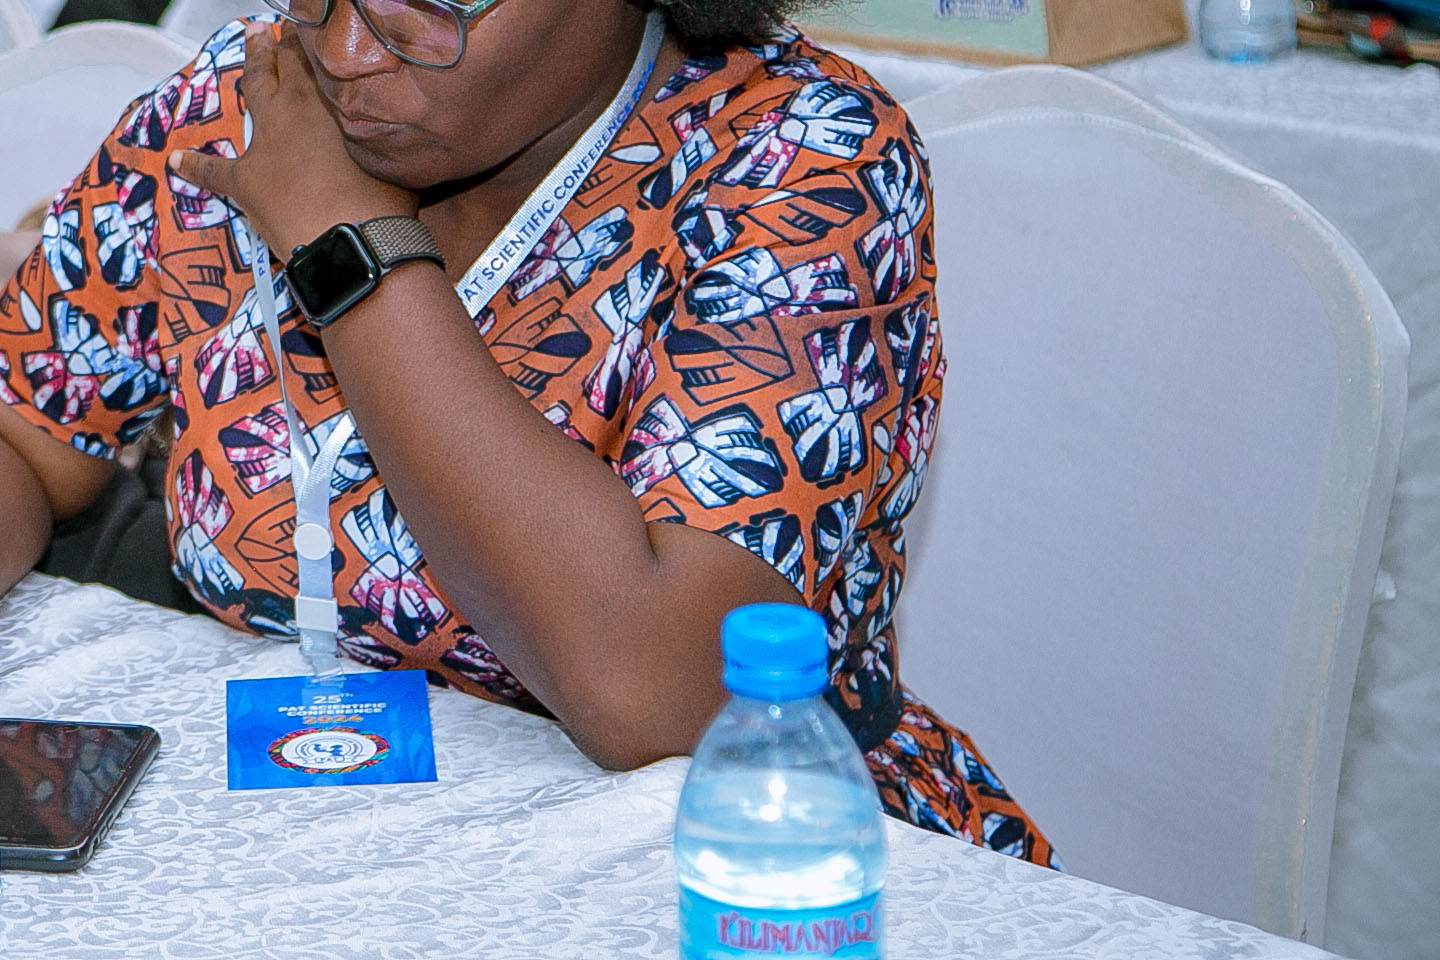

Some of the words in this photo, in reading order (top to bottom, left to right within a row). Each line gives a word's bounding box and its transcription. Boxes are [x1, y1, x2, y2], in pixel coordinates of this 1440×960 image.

[463, 277, 484, 302] AT
[482, 199, 555, 281] SCIENTIFIC
[553, 102, 632, 201] CONFERENCE
[309, 702, 387, 711] SCIENTIFIC
[286, 708, 383, 717] CONFERENCE
[303, 715, 364, 724] 2024
